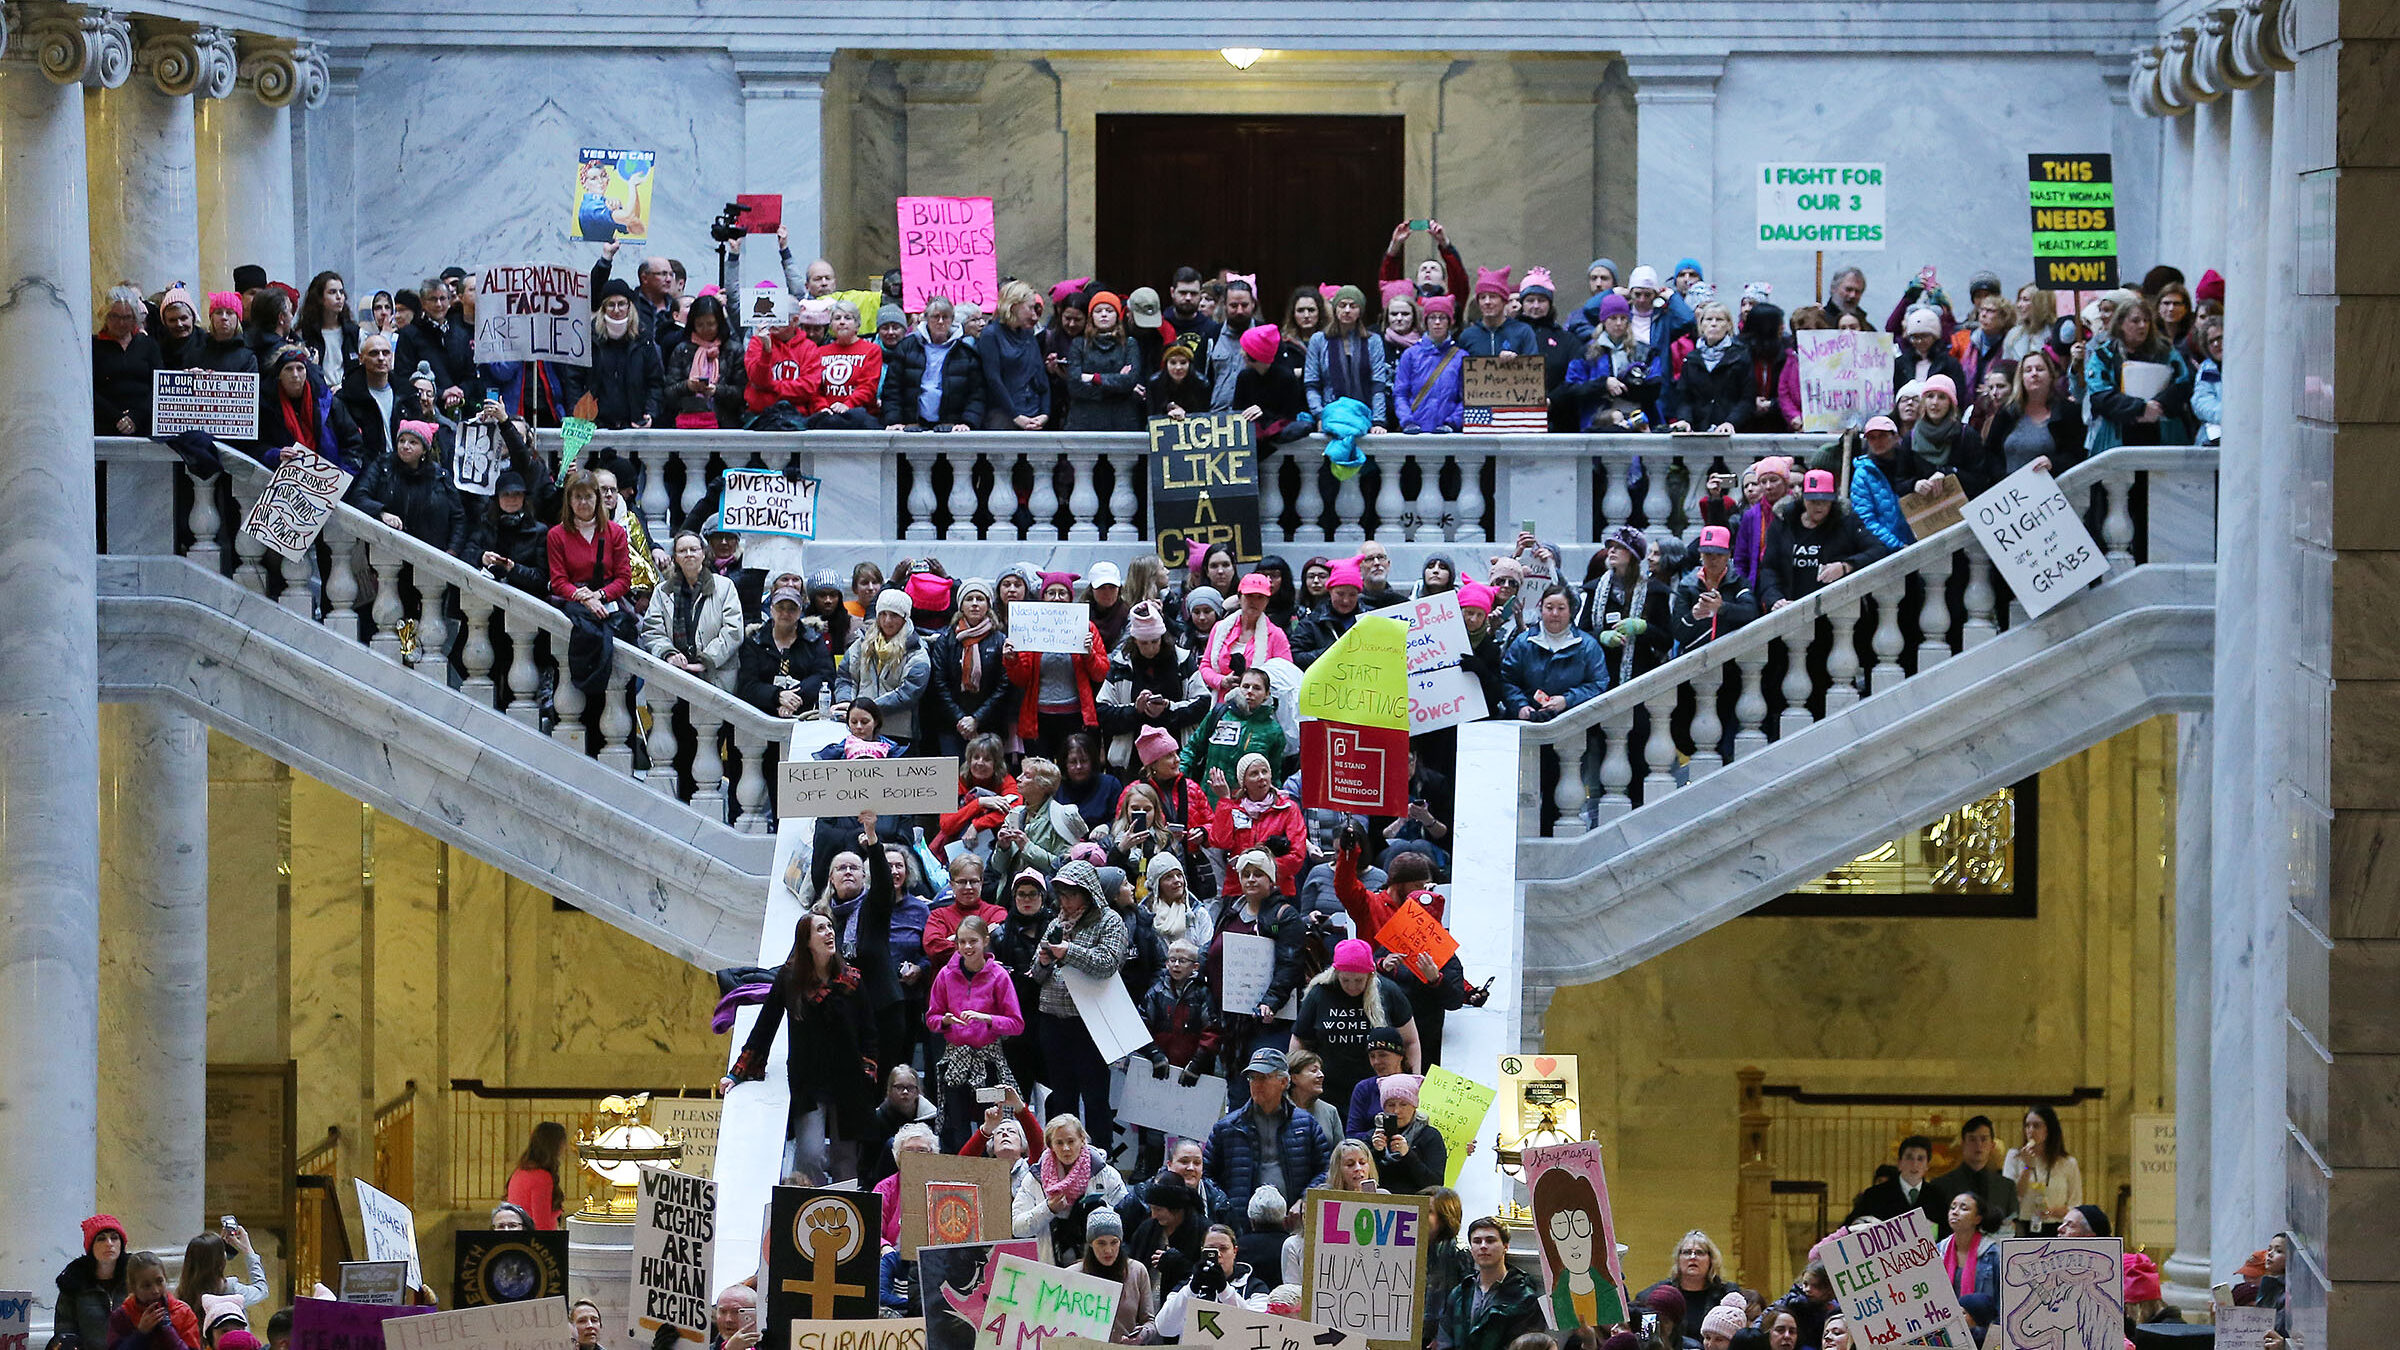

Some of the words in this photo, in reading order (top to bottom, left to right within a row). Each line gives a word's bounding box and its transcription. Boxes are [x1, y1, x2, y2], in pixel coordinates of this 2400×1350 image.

[607, 150, 628, 160] WE
[628, 152, 654, 161] CAN
[1764, 167, 1771, 185] I
[1776, 167, 1837, 186] FIGHT
[1841, 167, 1883, 186] FOR
[2041, 160, 2094, 182] THIS
[1797, 193, 1841, 211] OUR
[1849, 194, 1863, 212] 3
[2030, 191, 2066, 201] NASTY
[2068, 191, 2112, 201] WOMAN
[912, 201, 974, 226] BUILD
[2036, 208, 2108, 230] NEEDS
[906, 227, 994, 258] BRIDGES
[1760, 224, 1883, 242] DAUGHTERS
[2038, 239, 2109, 250] HEALTHCARE
[480, 265, 588, 299] ALTERNATIVE
[929, 258, 974, 282] NOT
[2048, 260, 2107, 283] NOW!
[506, 291, 570, 316] FACTS
[479, 316, 519, 341] ARE
[530, 316, 585, 358] LIES
[159, 374, 170, 386] IN
[174, 375, 193, 387] OUR
[159, 386, 193, 395] AMERICA
[194, 380, 221, 391] LOVE
[228, 381, 255, 392] WINS
[1149, 413, 1249, 453] FIGHT
[280, 467, 301, 480] OUR
[300, 473, 329, 493] BODIES
[1162, 450, 1251, 490] LIKE
[727, 472, 815, 499] DIVERSITY
[277, 485, 296, 502] OUR
[290, 494, 317, 522] MINDS
[1194, 490, 1218, 524] A
[1979, 488, 2029, 526] OUR
[254, 505, 273, 527] OUR
[270, 517, 301, 548] POWER
[724, 506, 809, 532] STRENGTH
[1993, 493, 2068, 552] RIGHTS
[2032, 545, 2091, 593] GRABS
[1408, 602, 1455, 632] People
[1406, 640, 1447, 672] ruth!
[1331, 662, 1383, 684] START
[1418, 680, 1434, 690] to
[1308, 682, 1409, 720] EDUCATING
[788, 766, 839, 783] KEEP
[847, 766, 885, 783] YOUR
[897, 765, 938, 777] LAWS
[1334, 760, 1344, 768] WE
[1344, 761, 1367, 771] STAND
[796, 789, 827, 802] OFF
[836, 788, 870, 801] OUR
[882, 786, 938, 798] BODIES
[1334, 776, 1363, 787] PLANNED
[1334, 785, 1380, 797] PARENTHOOD
[1322, 1020, 1368, 1031] WOME
[1329, 1007, 1365, 1018] NAST
[1561, 1147, 1598, 1169] nasty
[642, 1170, 716, 1213] WOMEN'S
[651, 1200, 714, 1243] RIGHTS
[1323, 1200, 1418, 1247] LOVE
[661, 1234, 703, 1268] ARE
[1836, 1240, 1849, 1265] I
[1856, 1211, 1919, 1259] DIDN'T
[461, 1244, 488, 1305] EARTH
[531, 1238, 561, 1294] WOMEN
[639, 1256, 707, 1300] HUMAN
[1319, 1252, 1412, 1292] HUMAN
[1834, 1260, 1881, 1297] FLEE
[1877, 1237, 1941, 1280] NARNIA
[646, 1288, 708, 1331] RIGHTS
[996, 1267, 1026, 1305] I
[1037, 1280, 1112, 1325] MARCH
[1853, 1289, 1884, 1321] just
[1887, 1283, 1907, 1306] to
[1911, 1281, 1930, 1300] go
[382, 1310, 478, 1350] THERE
[488, 1301, 565, 1333] WOULD
[1315, 1291, 1412, 1333] RIGHT!
[1864, 1317, 1902, 1346] back
[1904, 1317, 1922, 1334] in
[1923, 1299, 1952, 1325] the
[798, 1328, 926, 1350] SURVIVORS
[985, 1312, 1007, 1346] 4
[1246, 1323, 1300, 1350] I'm
